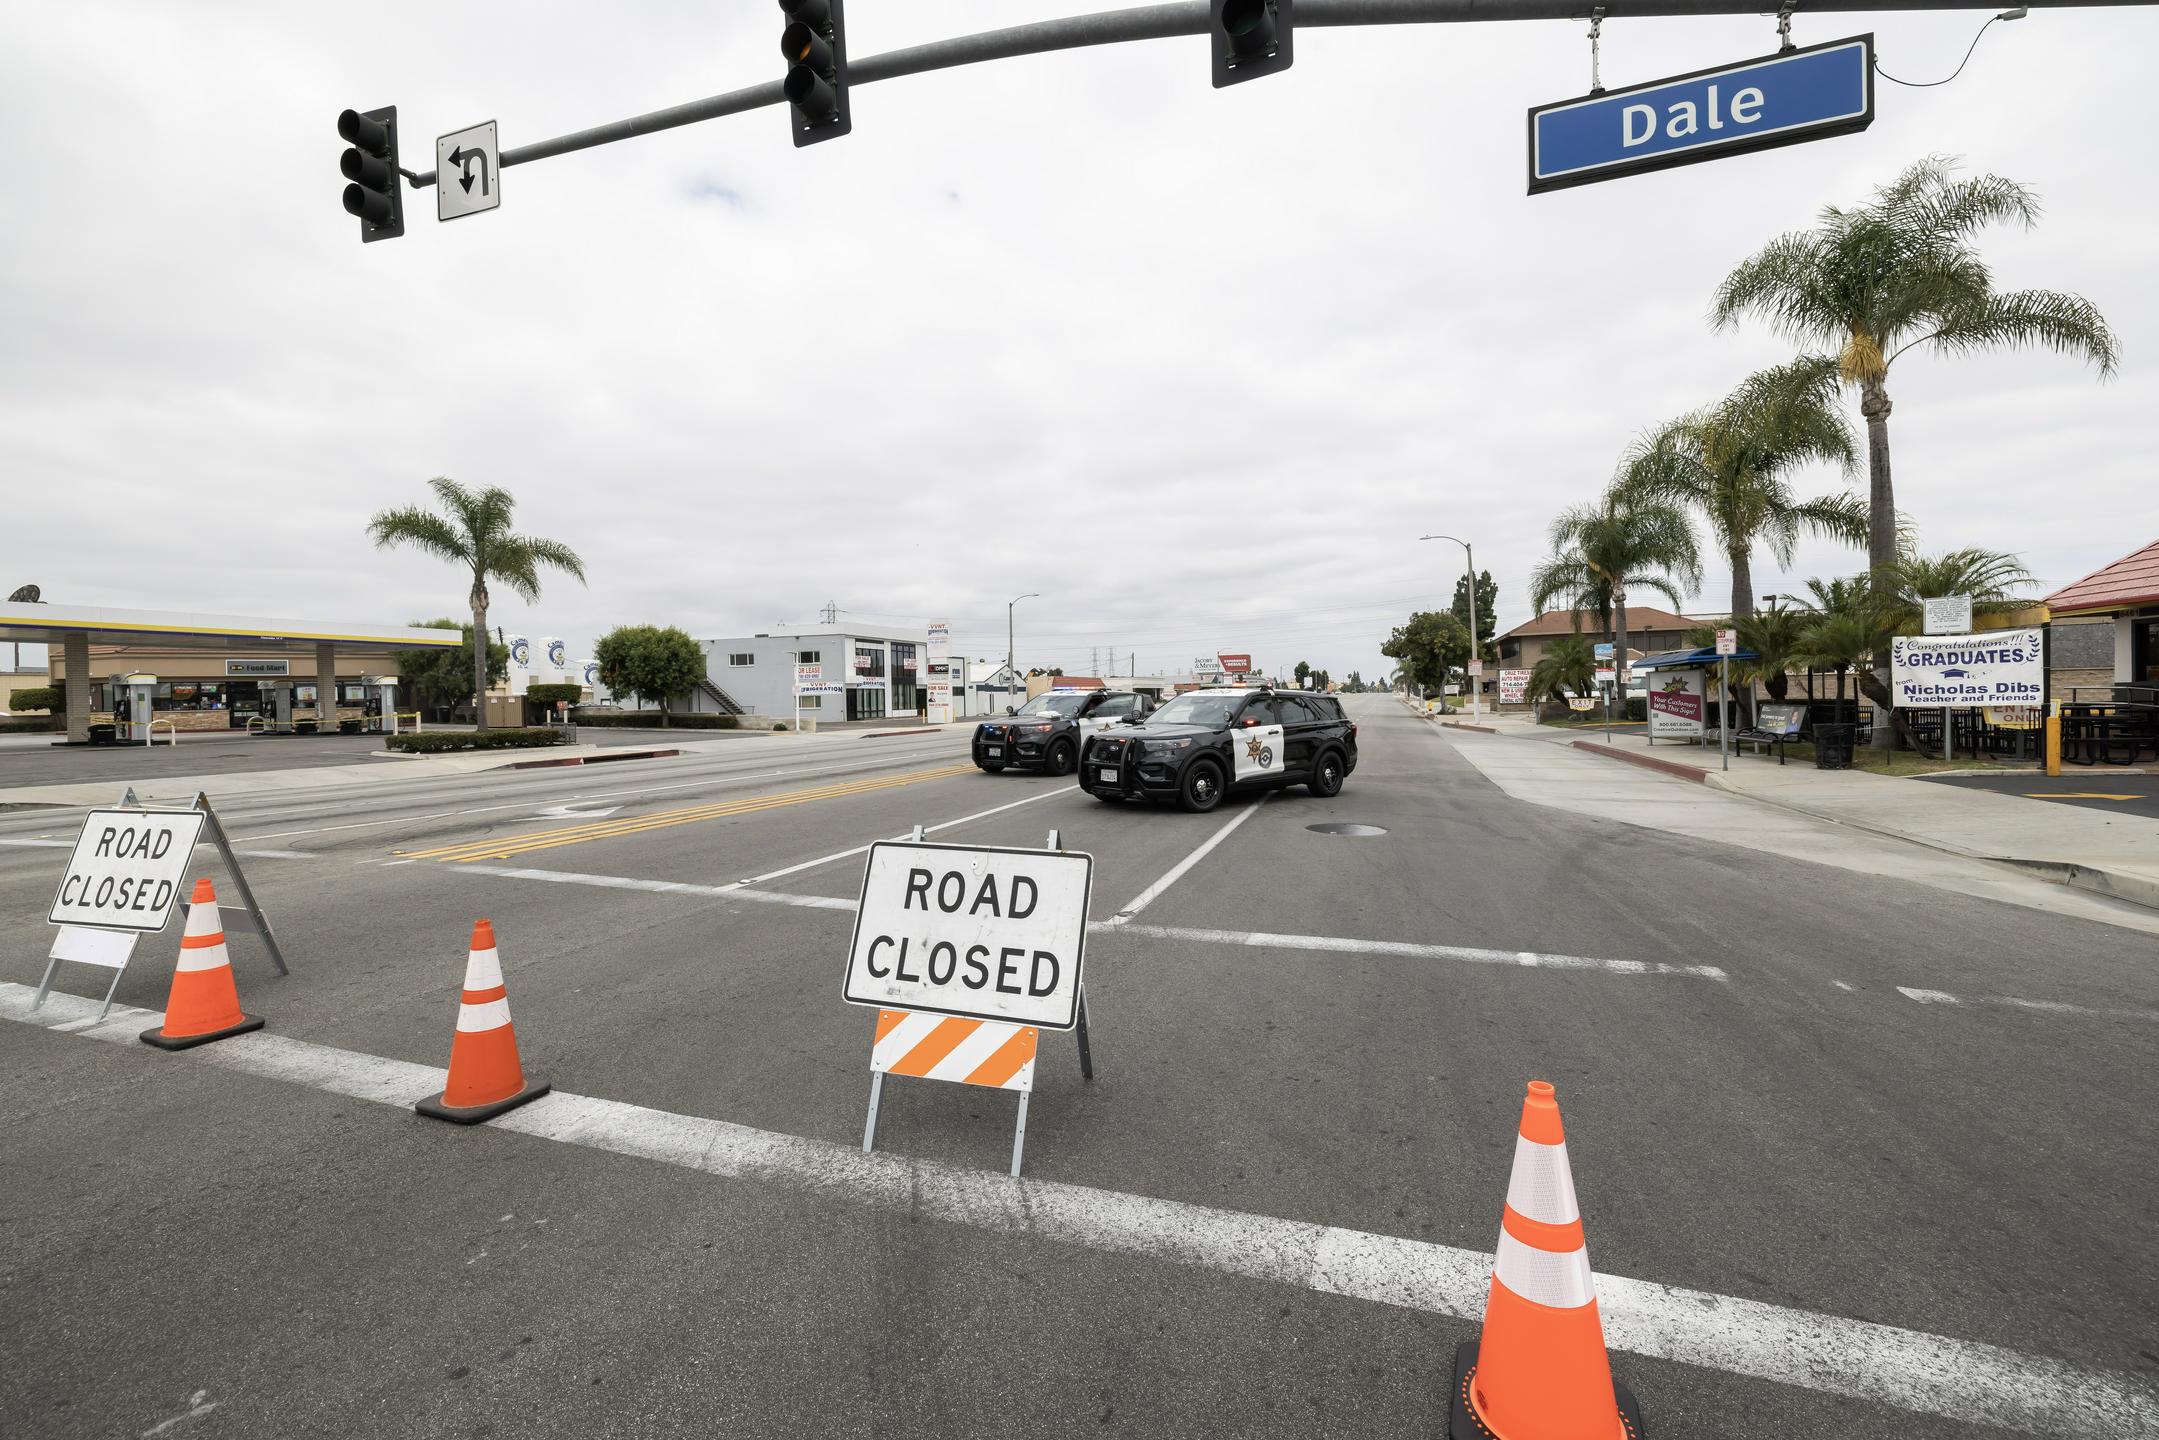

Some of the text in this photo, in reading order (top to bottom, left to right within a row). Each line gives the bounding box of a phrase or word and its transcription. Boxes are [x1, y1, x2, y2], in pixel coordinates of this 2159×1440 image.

[1623, 85, 1765, 148] Dale
[1907, 635, 2024, 652] Congratulations!!!
[1908, 648, 2024, 667] GRADUATES
[1895, 678, 1913, 686] from
[1904, 682, 2040, 695] Nicholas Dibs
[1668, 698, 1697, 708] Customers
[1989, 694, 2036, 702] Friends
[1680, 707, 1696, 715] Sign!
[95, 827, 173, 859] ROAD
[61, 874, 173, 911] CLOSED
[904, 868, 1038, 919] ROAD
[867, 935, 1060, 997] CLOSED
